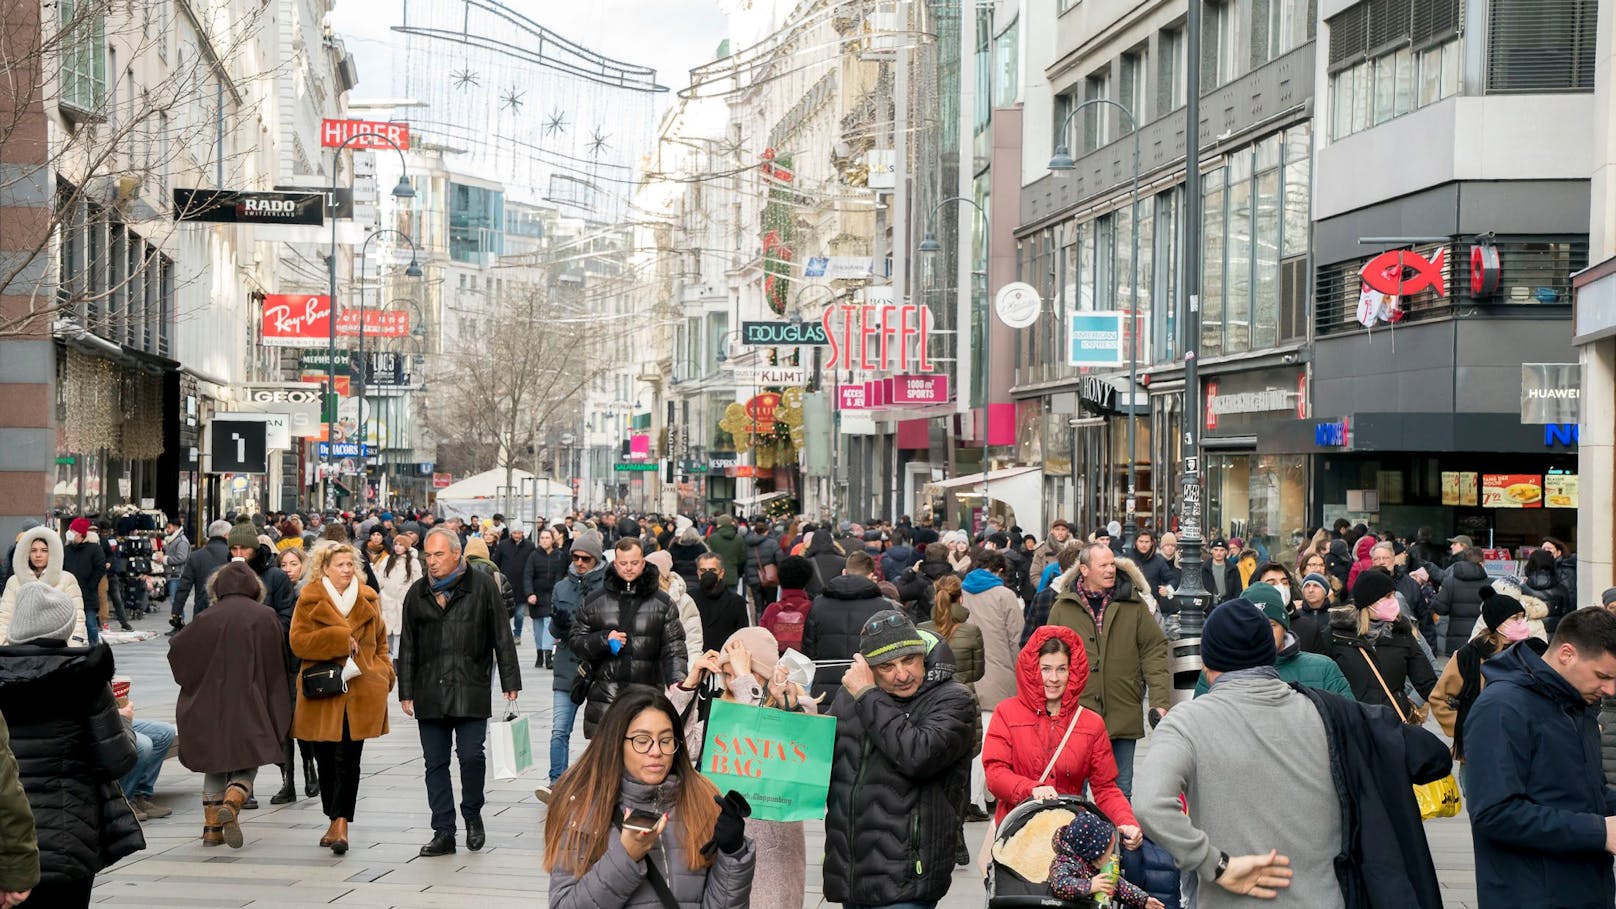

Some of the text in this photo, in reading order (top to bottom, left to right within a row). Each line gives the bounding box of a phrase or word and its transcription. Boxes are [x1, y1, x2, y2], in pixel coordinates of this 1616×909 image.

[325, 122, 401, 147] HUBER
[245, 199, 296, 212] RADO
[748, 325, 825, 342] DOUGLAS
[822, 304, 933, 371] STEFFL
[1071, 331, 1116, 339] AMERICAN
[761, 371, 803, 382] KLIMT
[254, 391, 323, 404] GEOX
[907, 389, 935, 399] SPORTS
[1528, 388, 1580, 399] HUAWEI
[713, 733, 807, 763] SANTA'S
[711, 754, 763, 778] BAG
